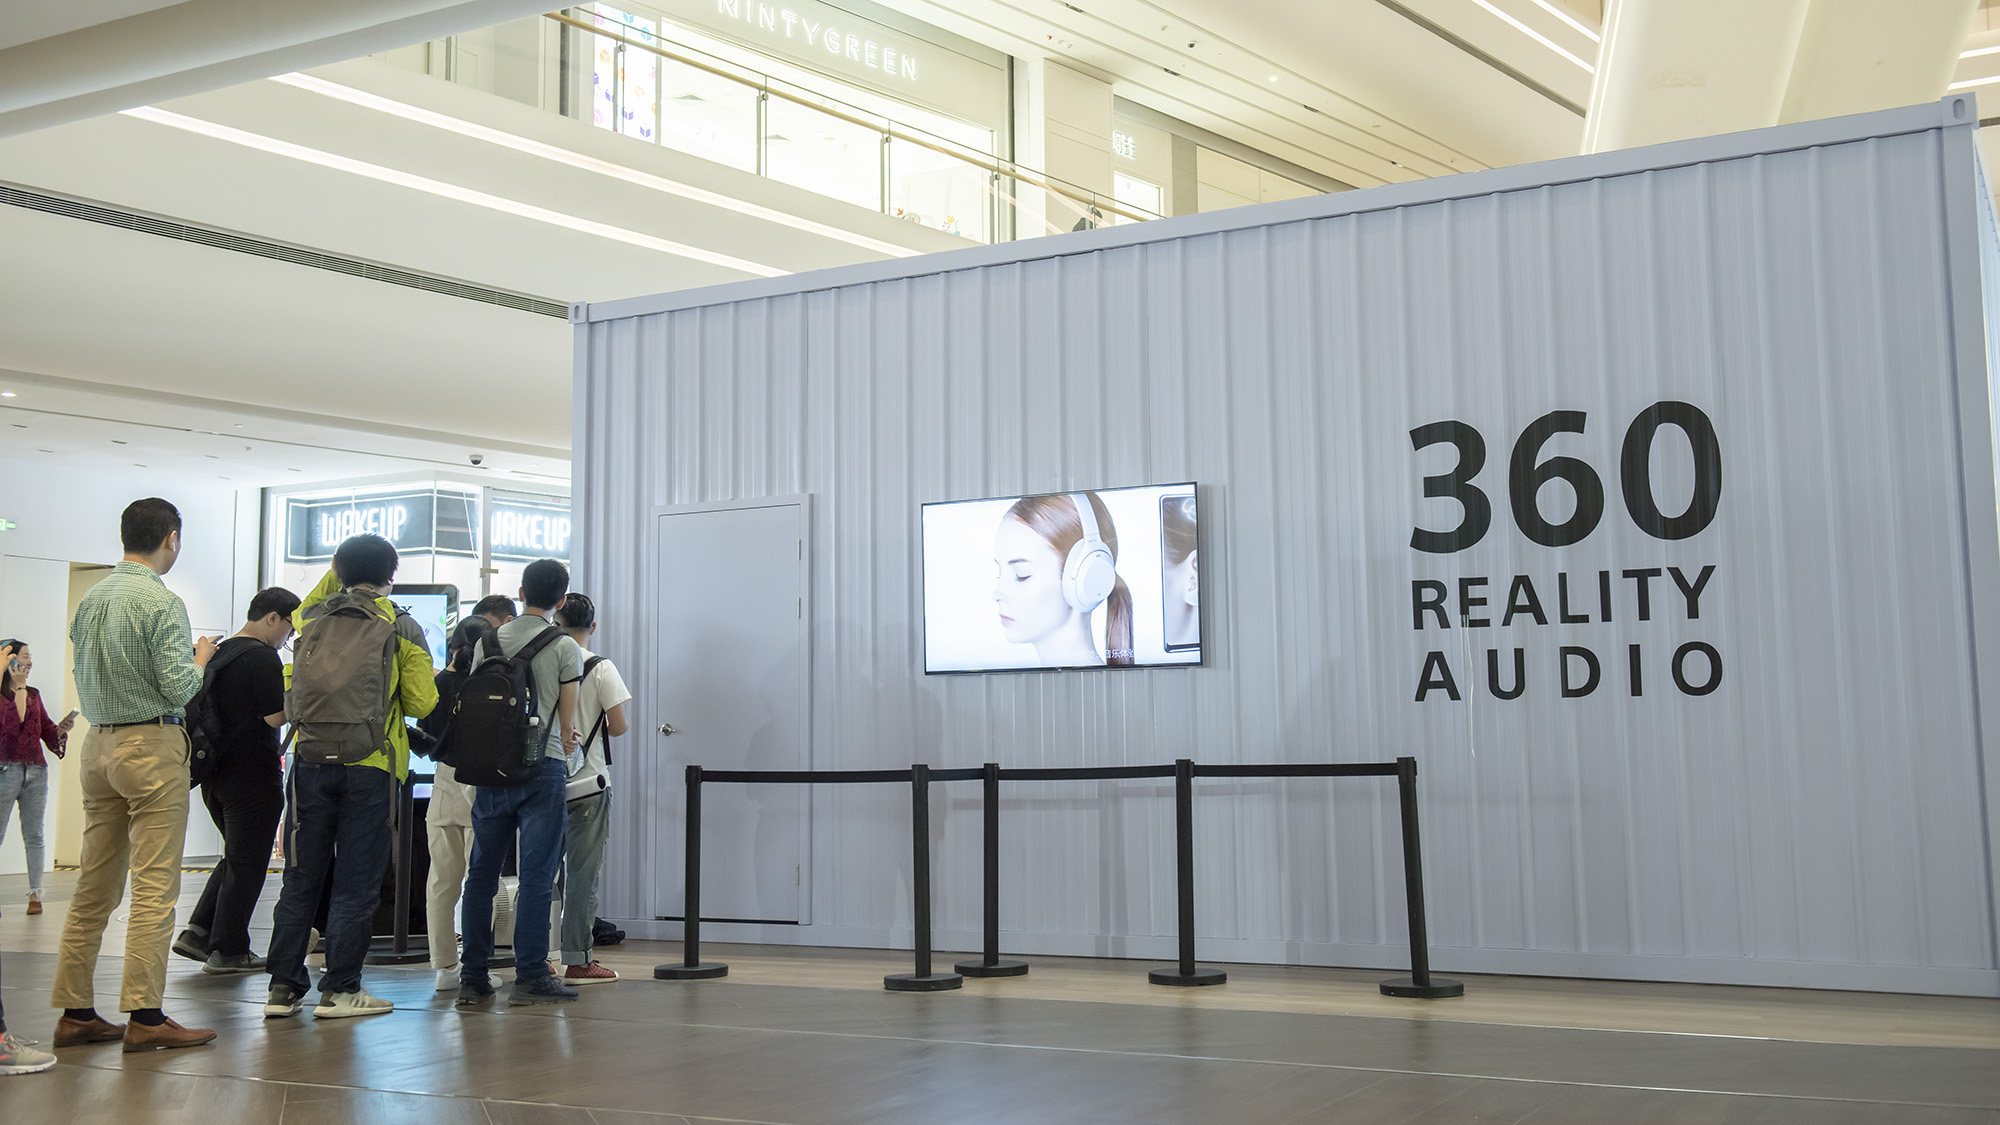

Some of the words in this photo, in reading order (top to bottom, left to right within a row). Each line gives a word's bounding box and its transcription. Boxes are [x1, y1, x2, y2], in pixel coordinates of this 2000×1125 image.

[718, 0, 917, 80] MINTYGREEN
[1409, 401, 1722, 553] 360
[322, 505, 406, 547] WAKEUP
[1411, 565, 1716, 630] REALITY
[1415, 641, 1722, 702] AUDIO
